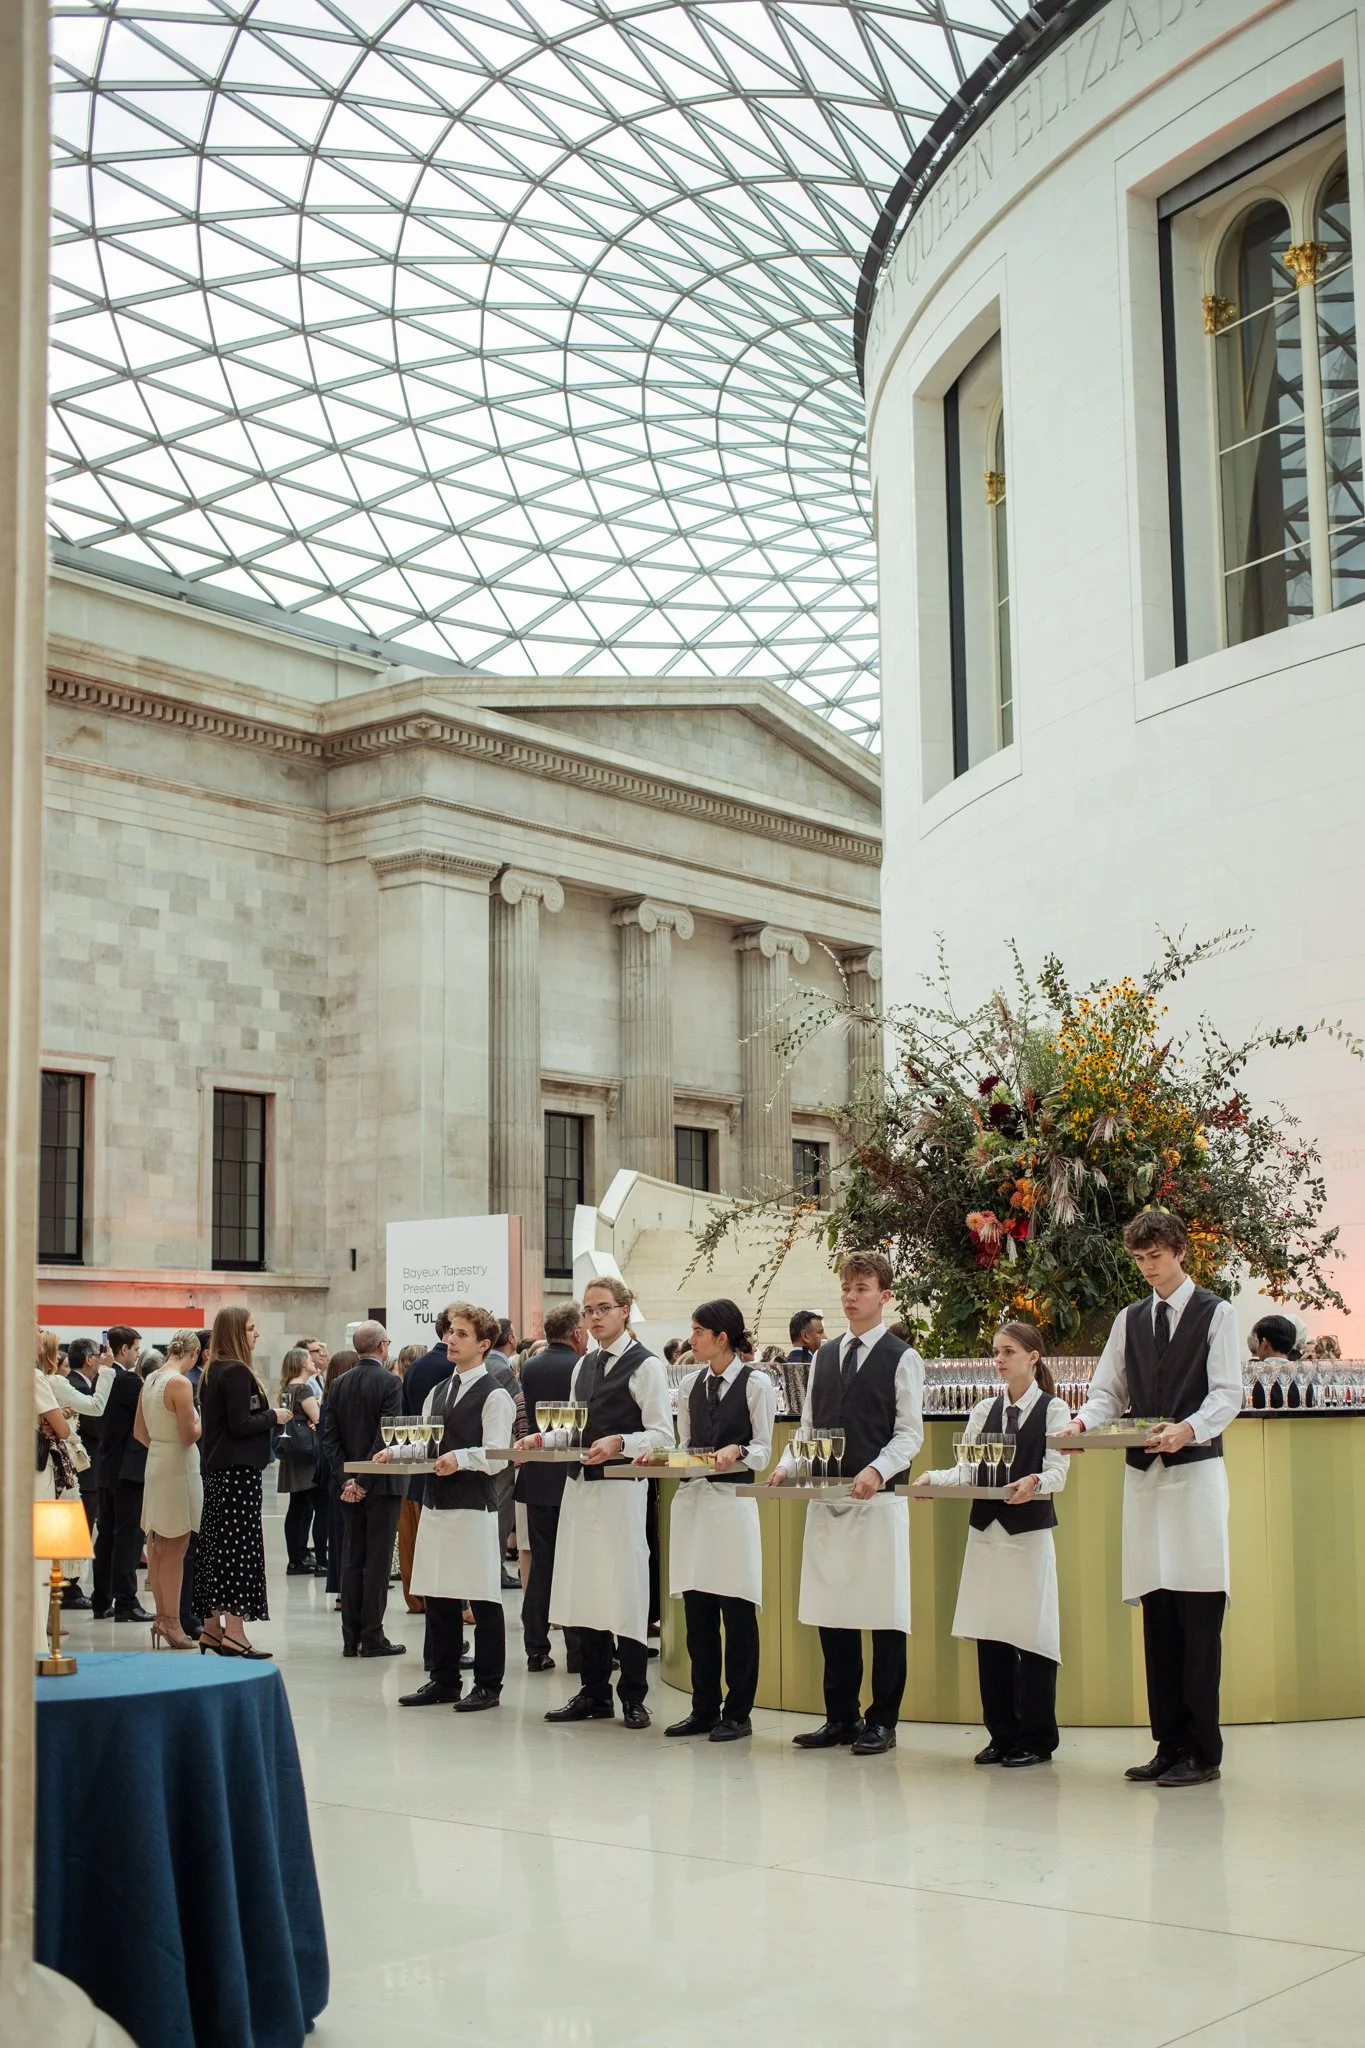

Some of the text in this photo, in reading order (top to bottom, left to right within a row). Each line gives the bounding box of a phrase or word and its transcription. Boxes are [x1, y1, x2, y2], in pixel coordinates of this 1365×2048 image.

[906, 120, 994, 286] QUEEN
[403, 1265, 486, 1279] Bayeux Tapestry
[403, 1281, 470, 1294] Presented By
[402, 1299, 429, 1311] IGOR
